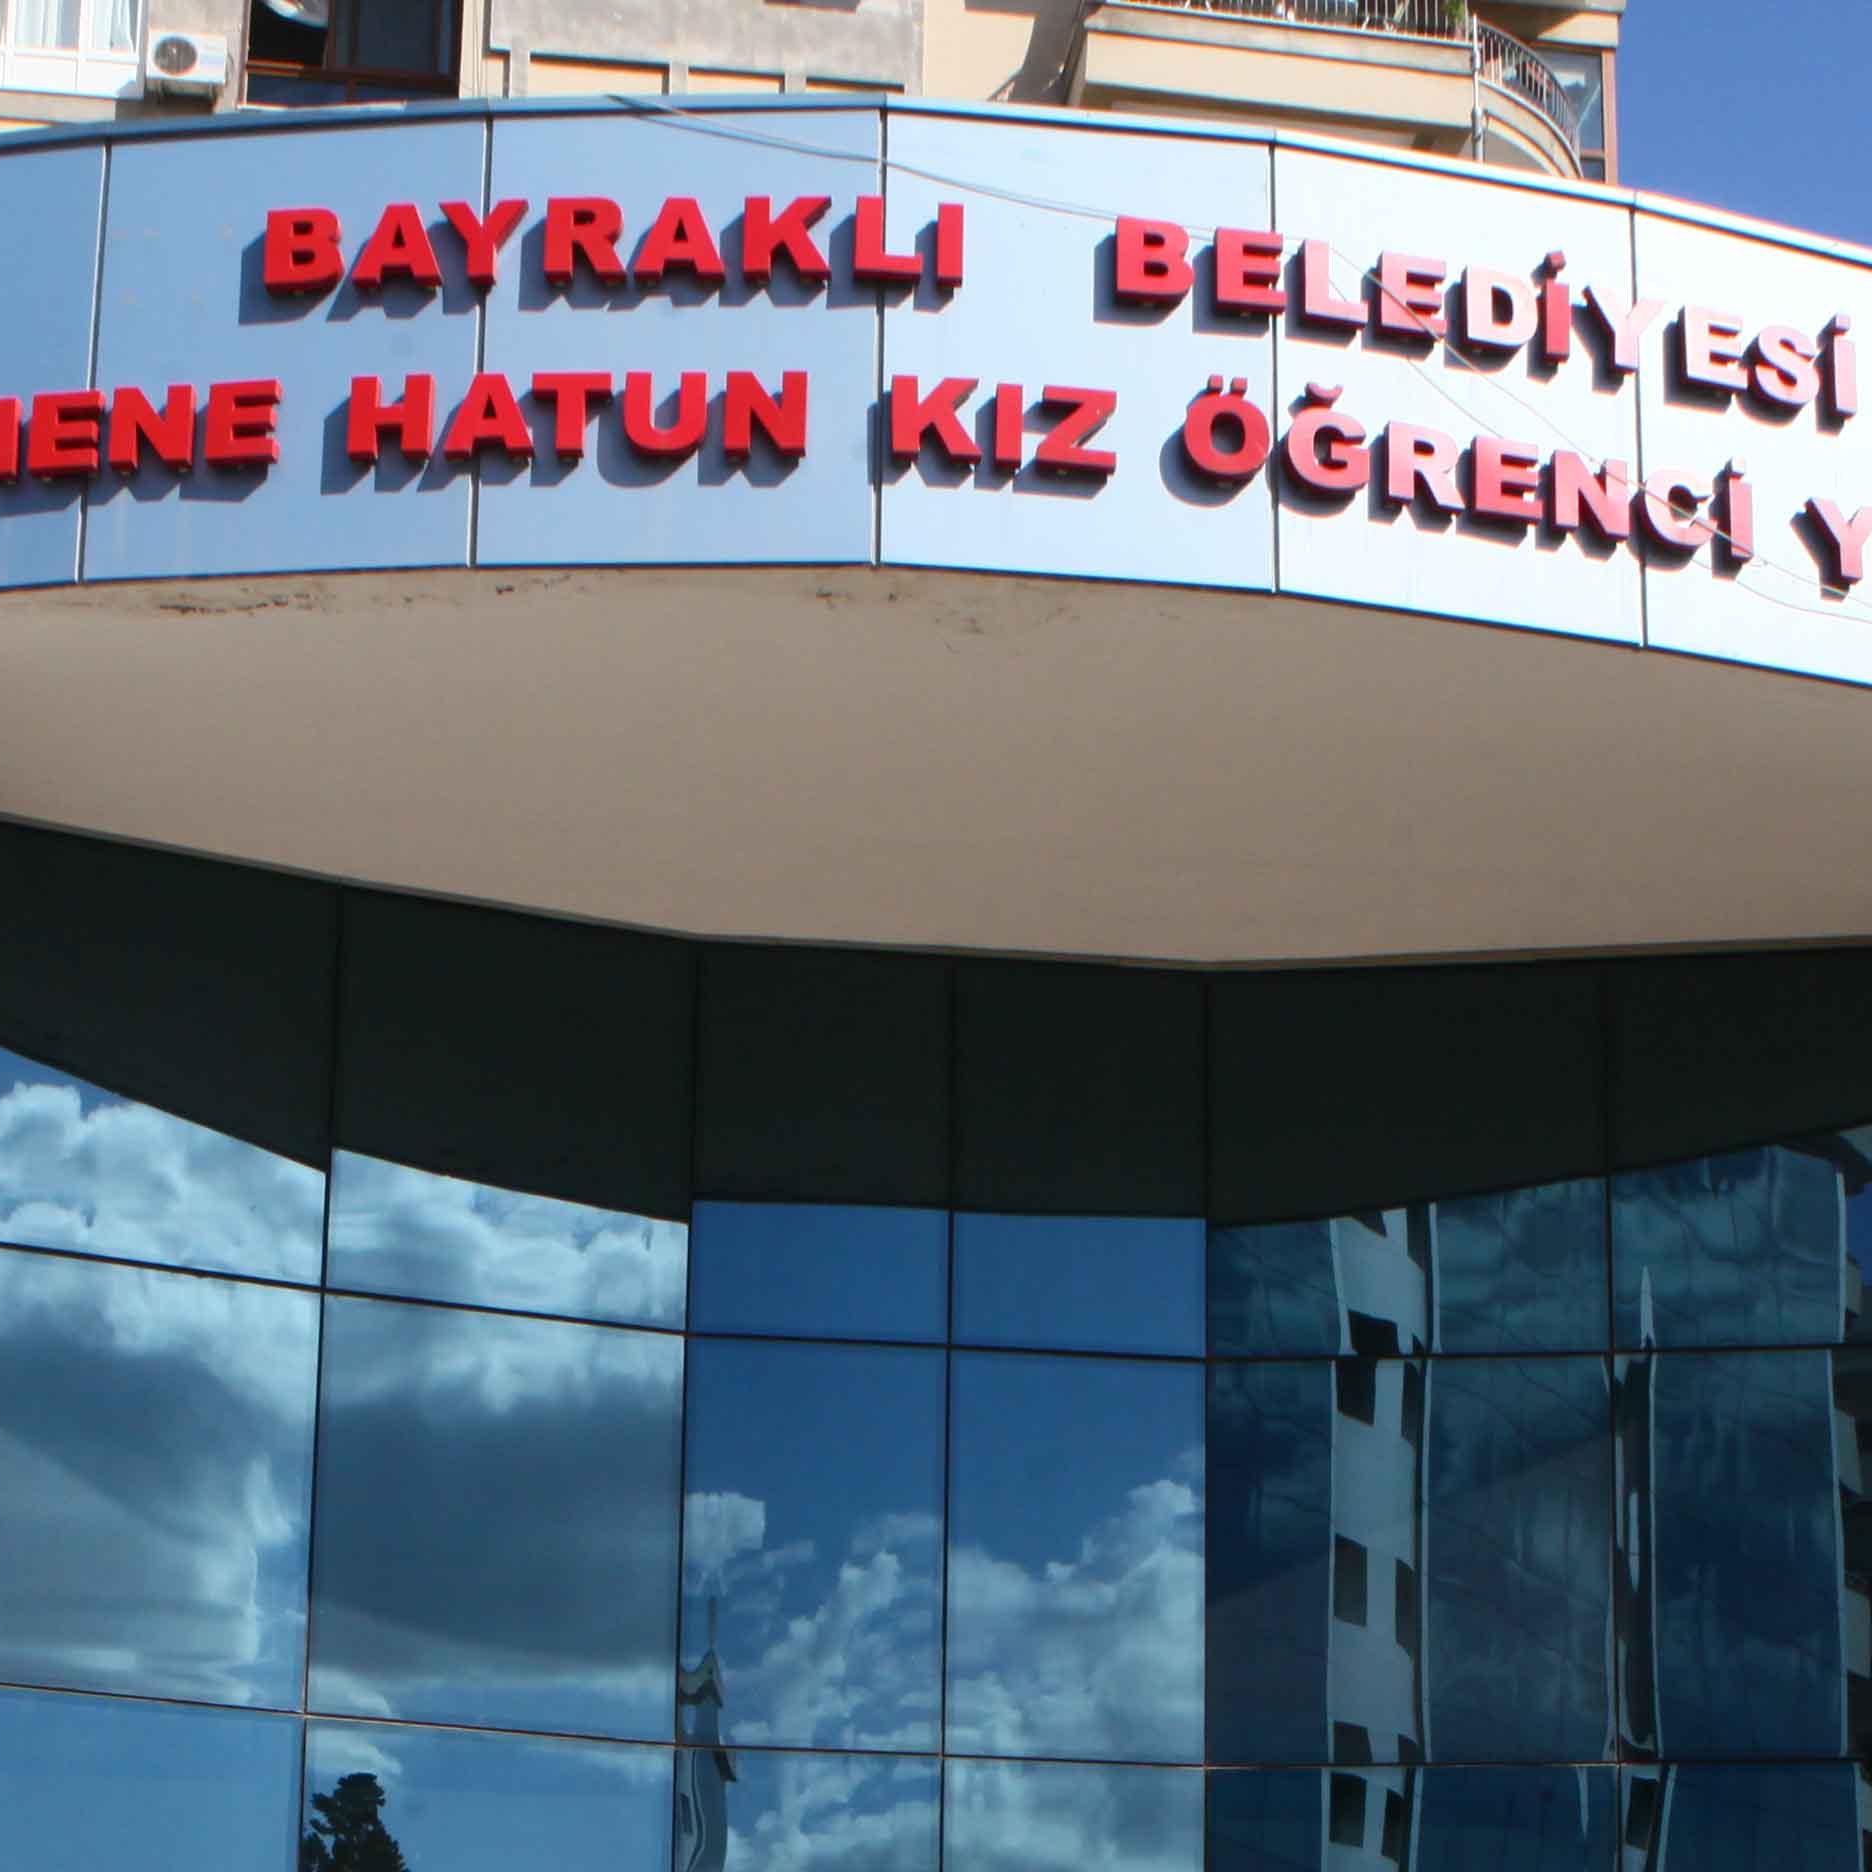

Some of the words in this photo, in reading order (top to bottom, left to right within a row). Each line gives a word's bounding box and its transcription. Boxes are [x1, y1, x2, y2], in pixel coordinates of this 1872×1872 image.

[262, 195, 965, 299] BAYRAKLI
[1114, 213, 1859, 420] BELEDİYESİ
[346, 370, 808, 463] HATUN
[891, 375, 1117, 478] KIZ
[1182, 374, 1755, 563] ÖĞRENCİ
